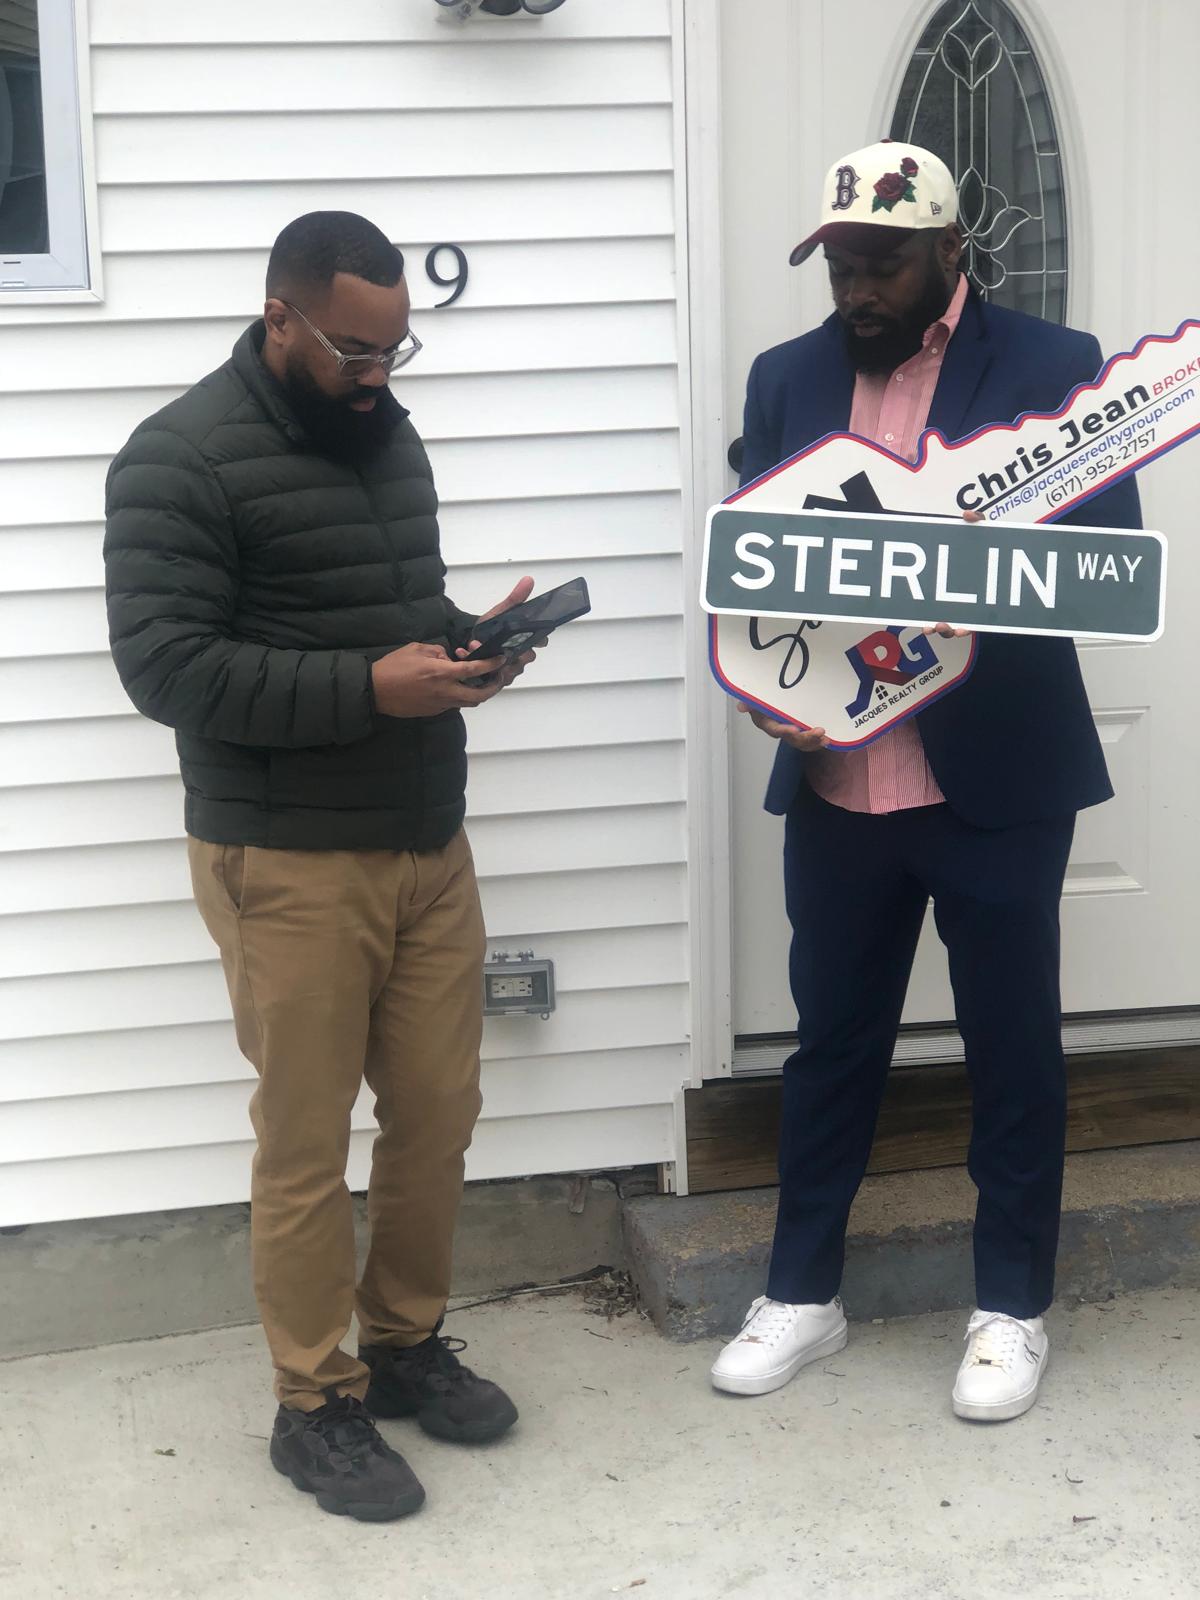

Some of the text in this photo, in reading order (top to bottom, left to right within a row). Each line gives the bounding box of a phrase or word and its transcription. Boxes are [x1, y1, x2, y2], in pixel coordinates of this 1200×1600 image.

[831, 164, 861, 211] B
[425, 243, 469, 309] 9
[955, 442, 1054, 511] Chris
[1059, 385, 1151, 449] Jean
[989, 387, 1195, 521] chris@jacquesrealtygroup.com
[1046, 428, 1156, 508] (617)-952-2757
[730, 531, 1143, 609] STERLIN WAY
[854, 666, 944, 728] JACQUES REALTY GROUP
